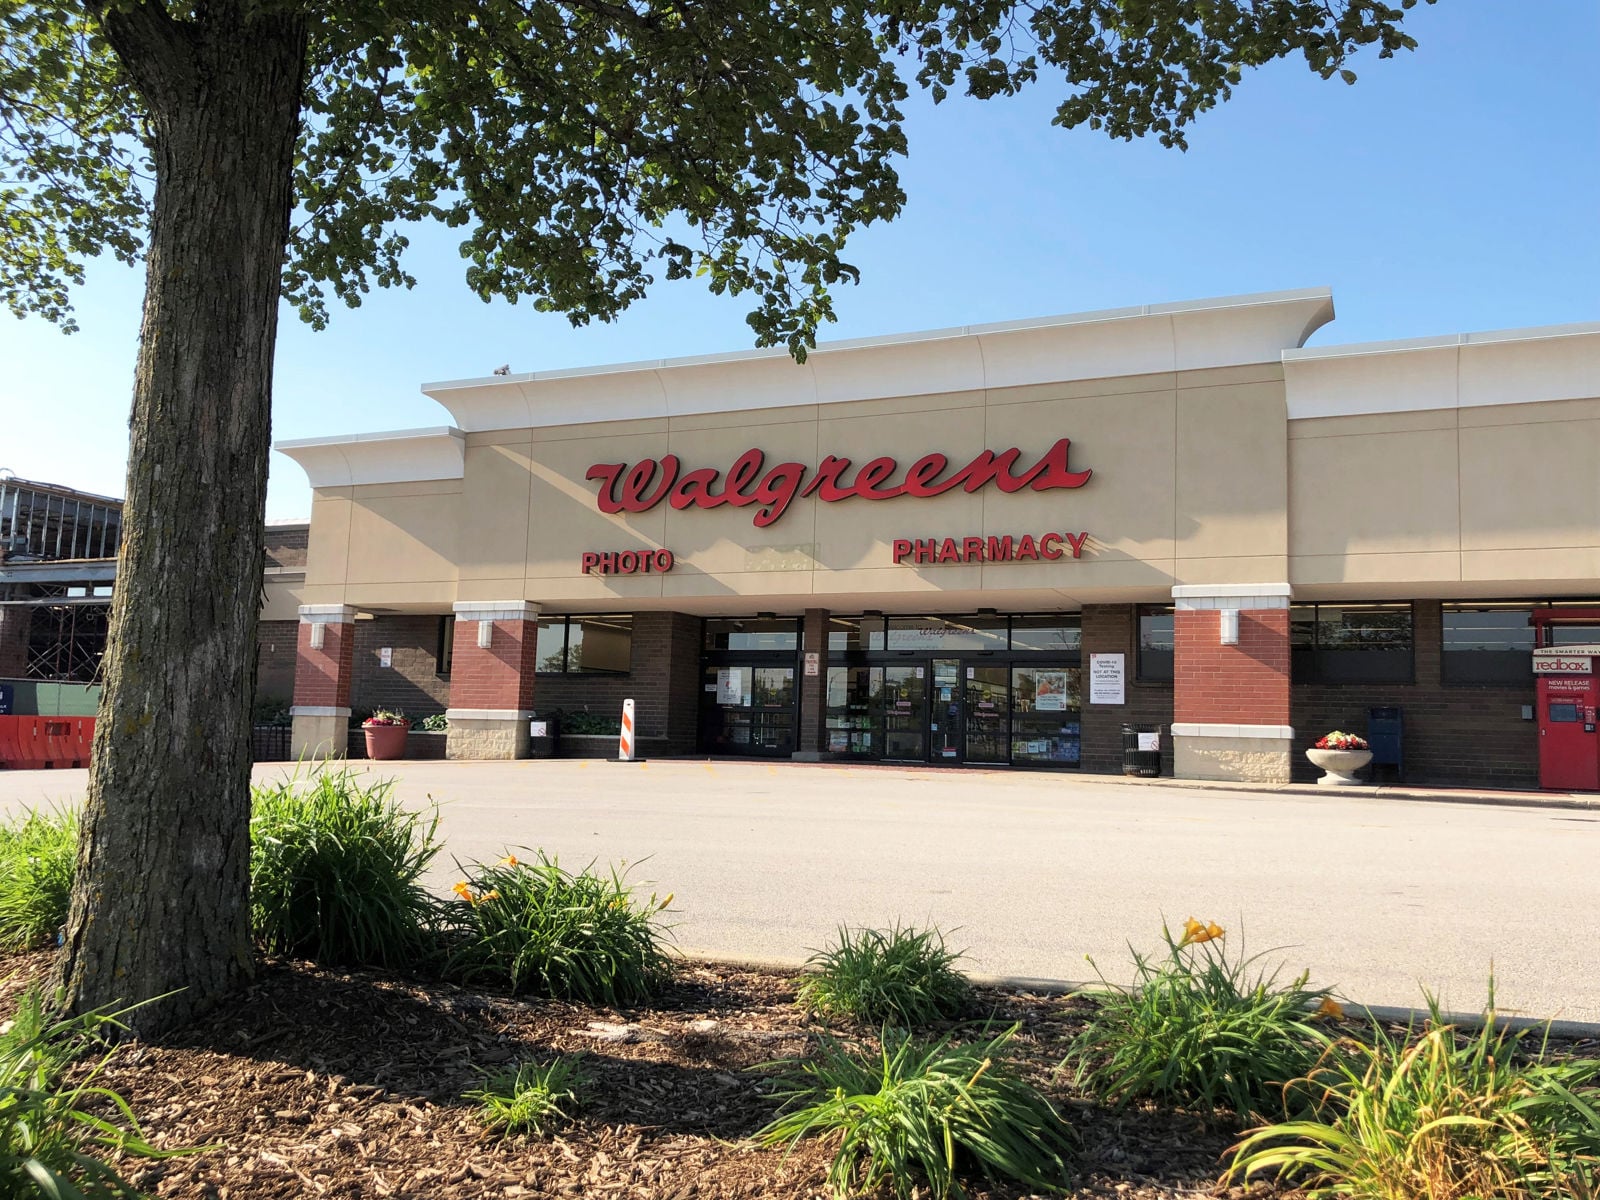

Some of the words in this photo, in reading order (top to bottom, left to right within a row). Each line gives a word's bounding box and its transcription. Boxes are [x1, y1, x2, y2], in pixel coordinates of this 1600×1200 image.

[585, 438, 1093, 528] Walgreens
[582, 549, 674, 574] PHOTO
[893, 532, 1088, 564] PHARMACY
